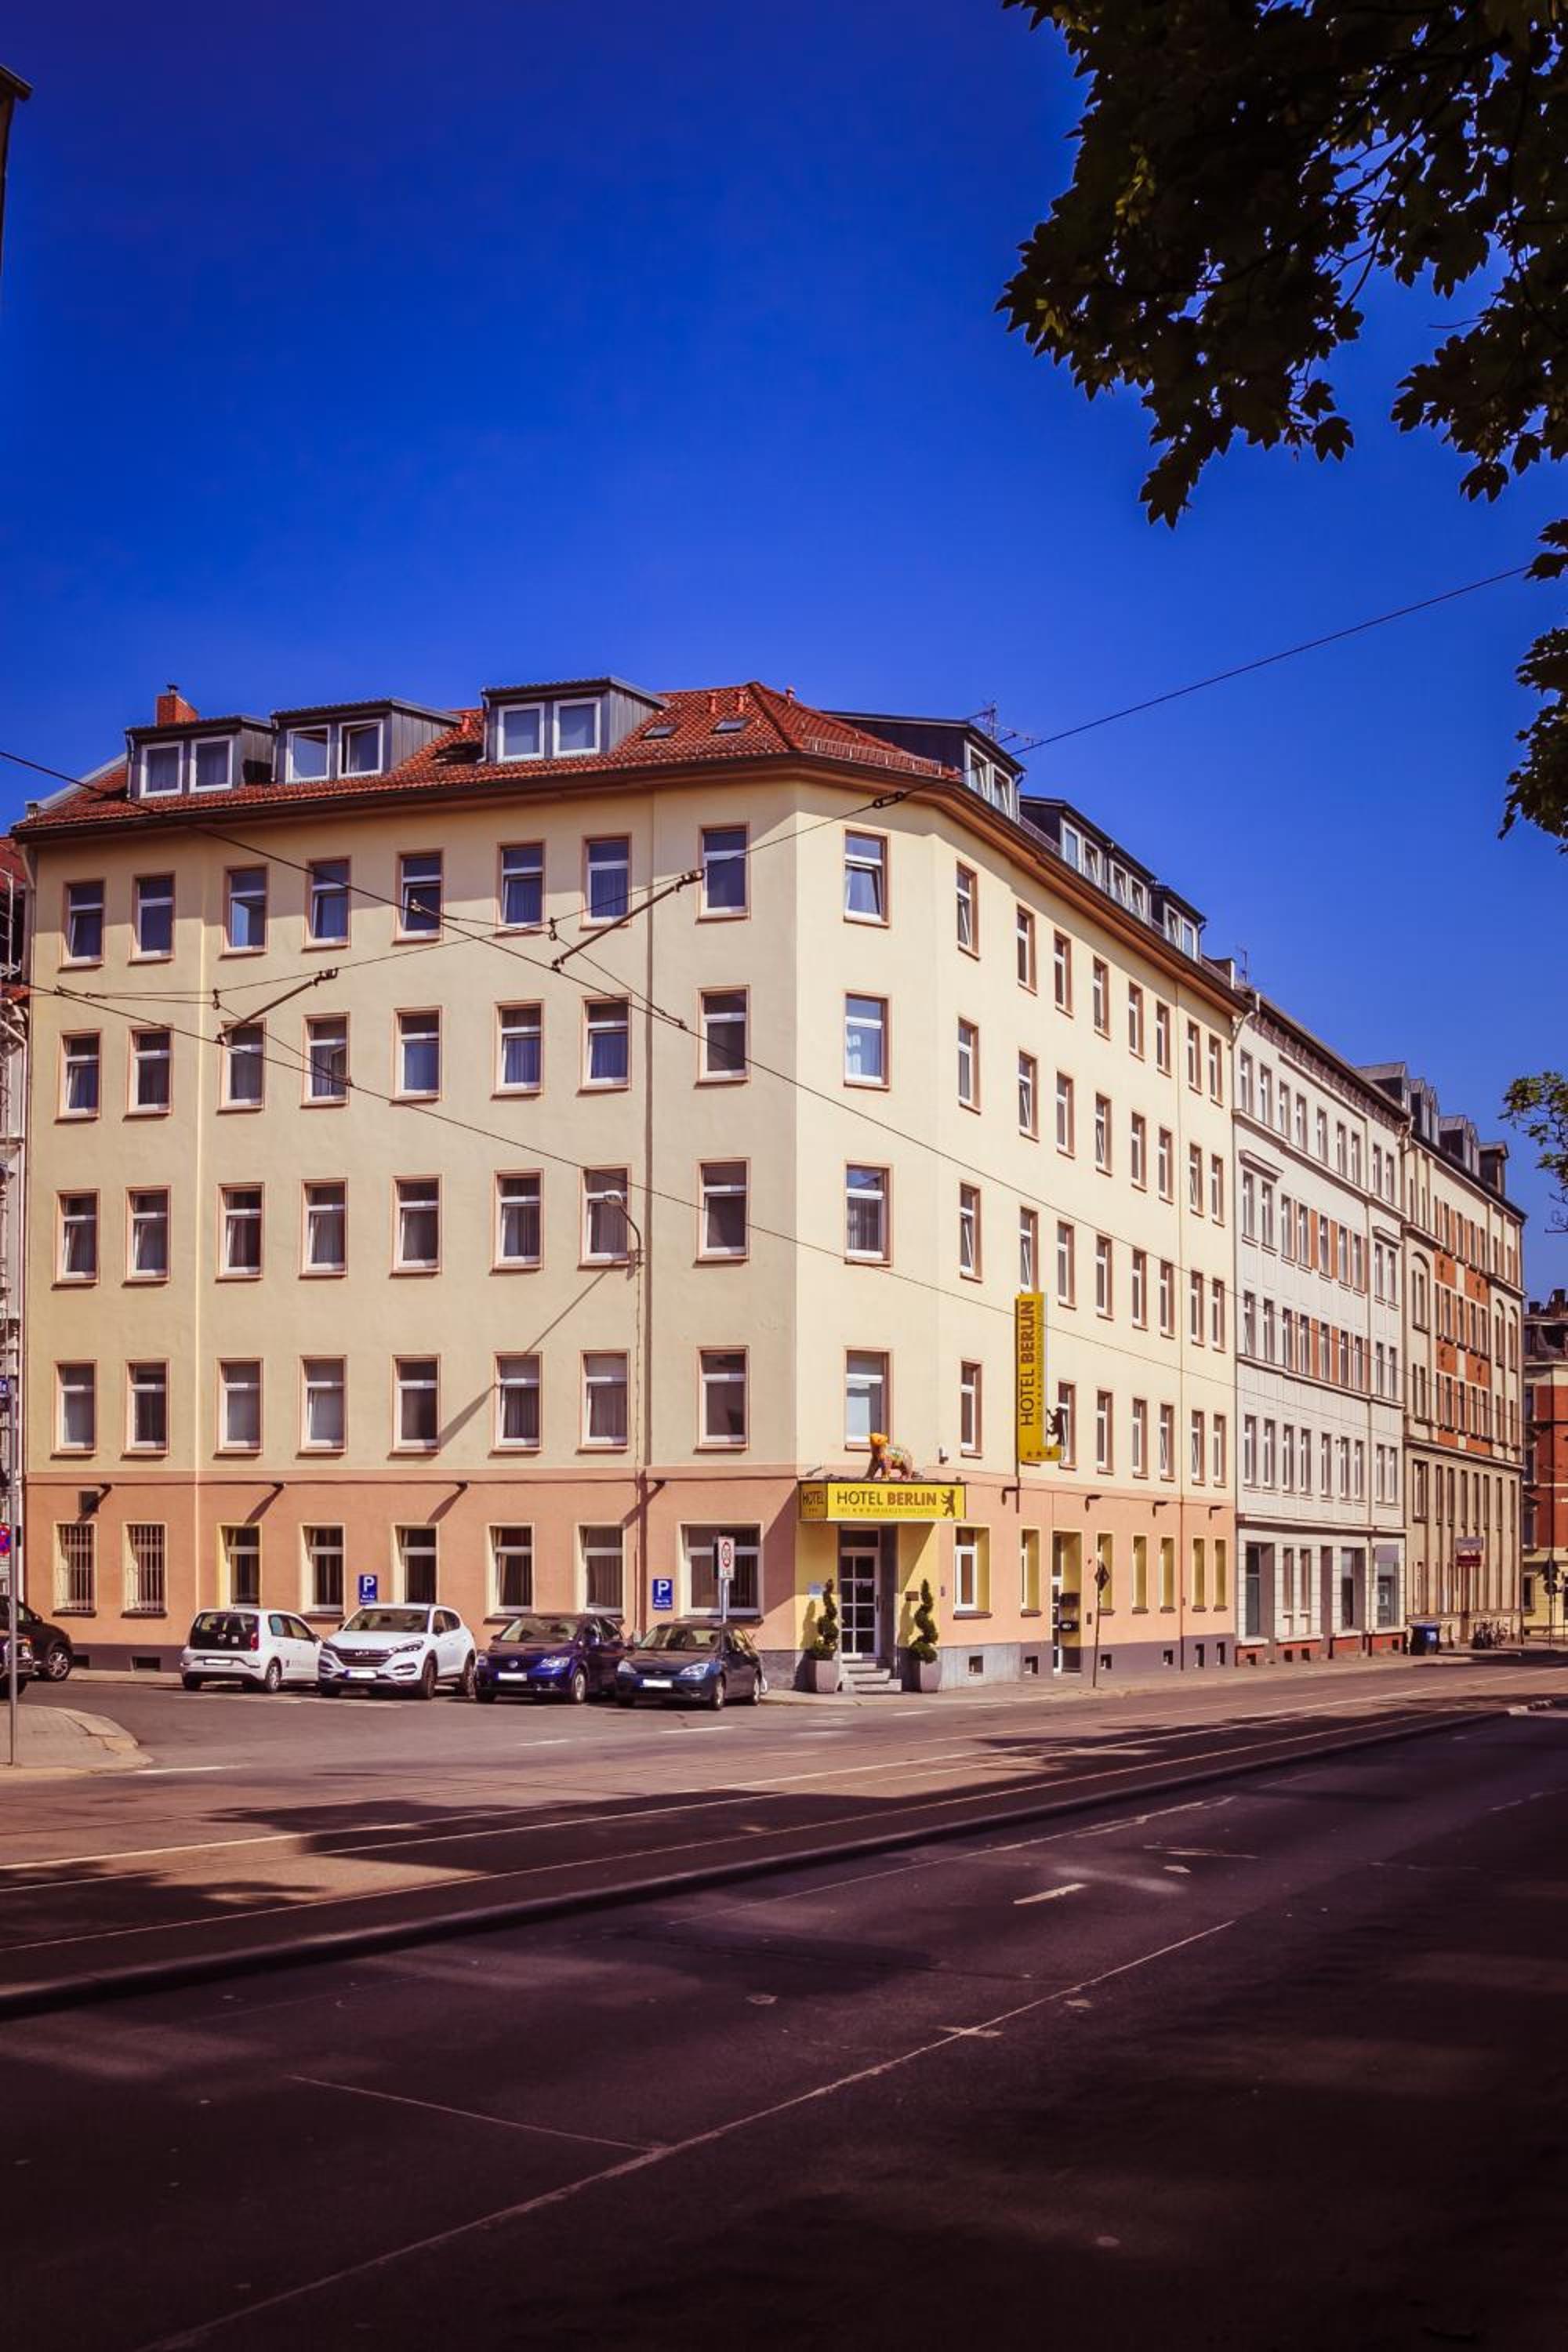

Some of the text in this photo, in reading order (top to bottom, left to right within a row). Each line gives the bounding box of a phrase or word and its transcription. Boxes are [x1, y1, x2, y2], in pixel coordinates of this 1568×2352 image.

[1020, 1301, 1035, 1426] HOTEL BERLIN
[836, 1490, 937, 1506] HOTEL BERLIN
[363, 1576, 375, 1592] P
[658, 1580, 670, 1597] P
